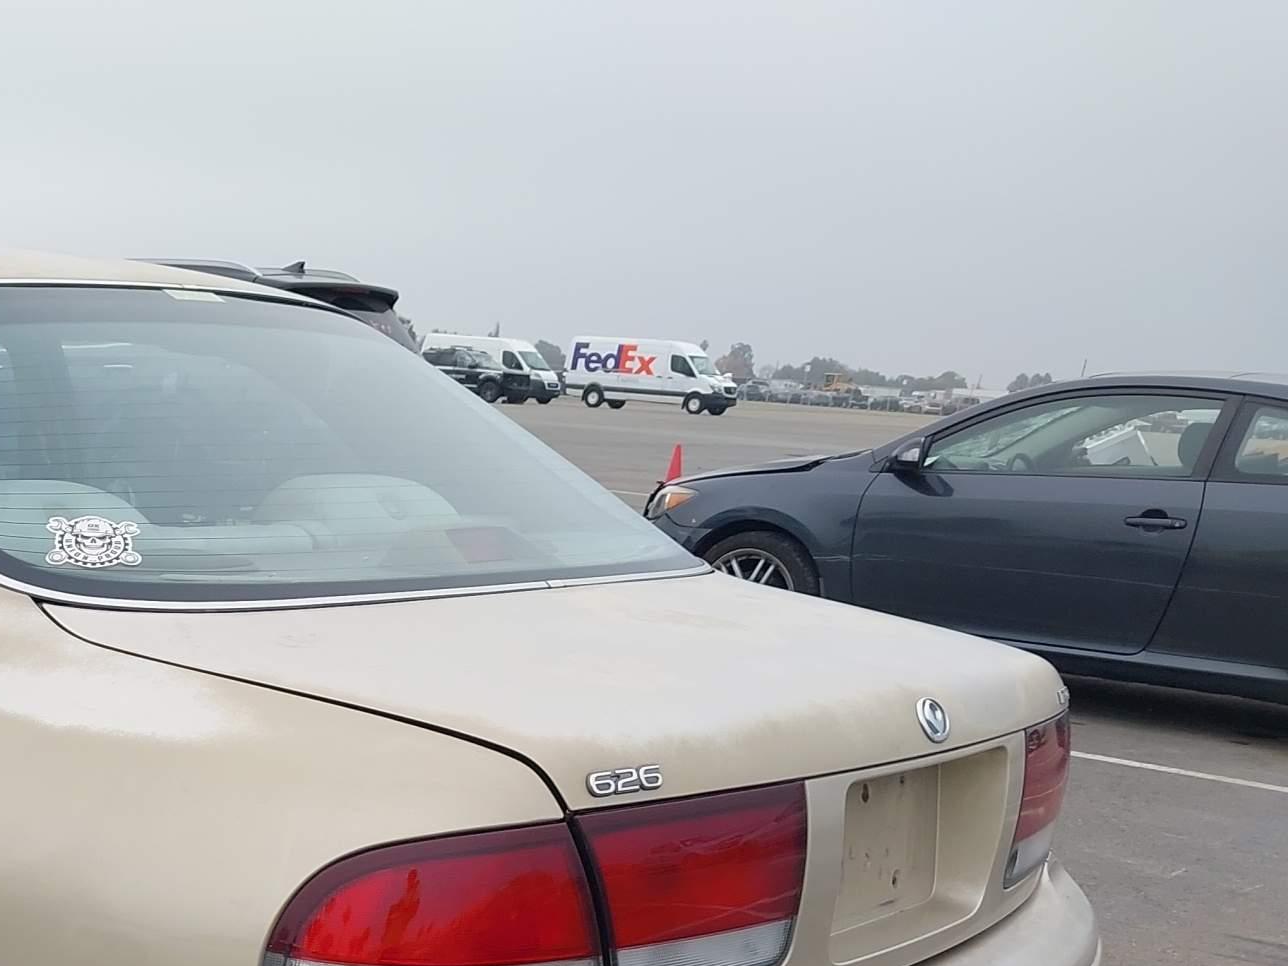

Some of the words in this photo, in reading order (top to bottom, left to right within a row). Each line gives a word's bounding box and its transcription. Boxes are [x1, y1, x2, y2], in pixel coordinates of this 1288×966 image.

[570, 342, 657, 376] FedEx
[64, 538, 89, 561] UNION
[97, 539, 122, 562] PROUD
[587, 764, 663, 796] 626
